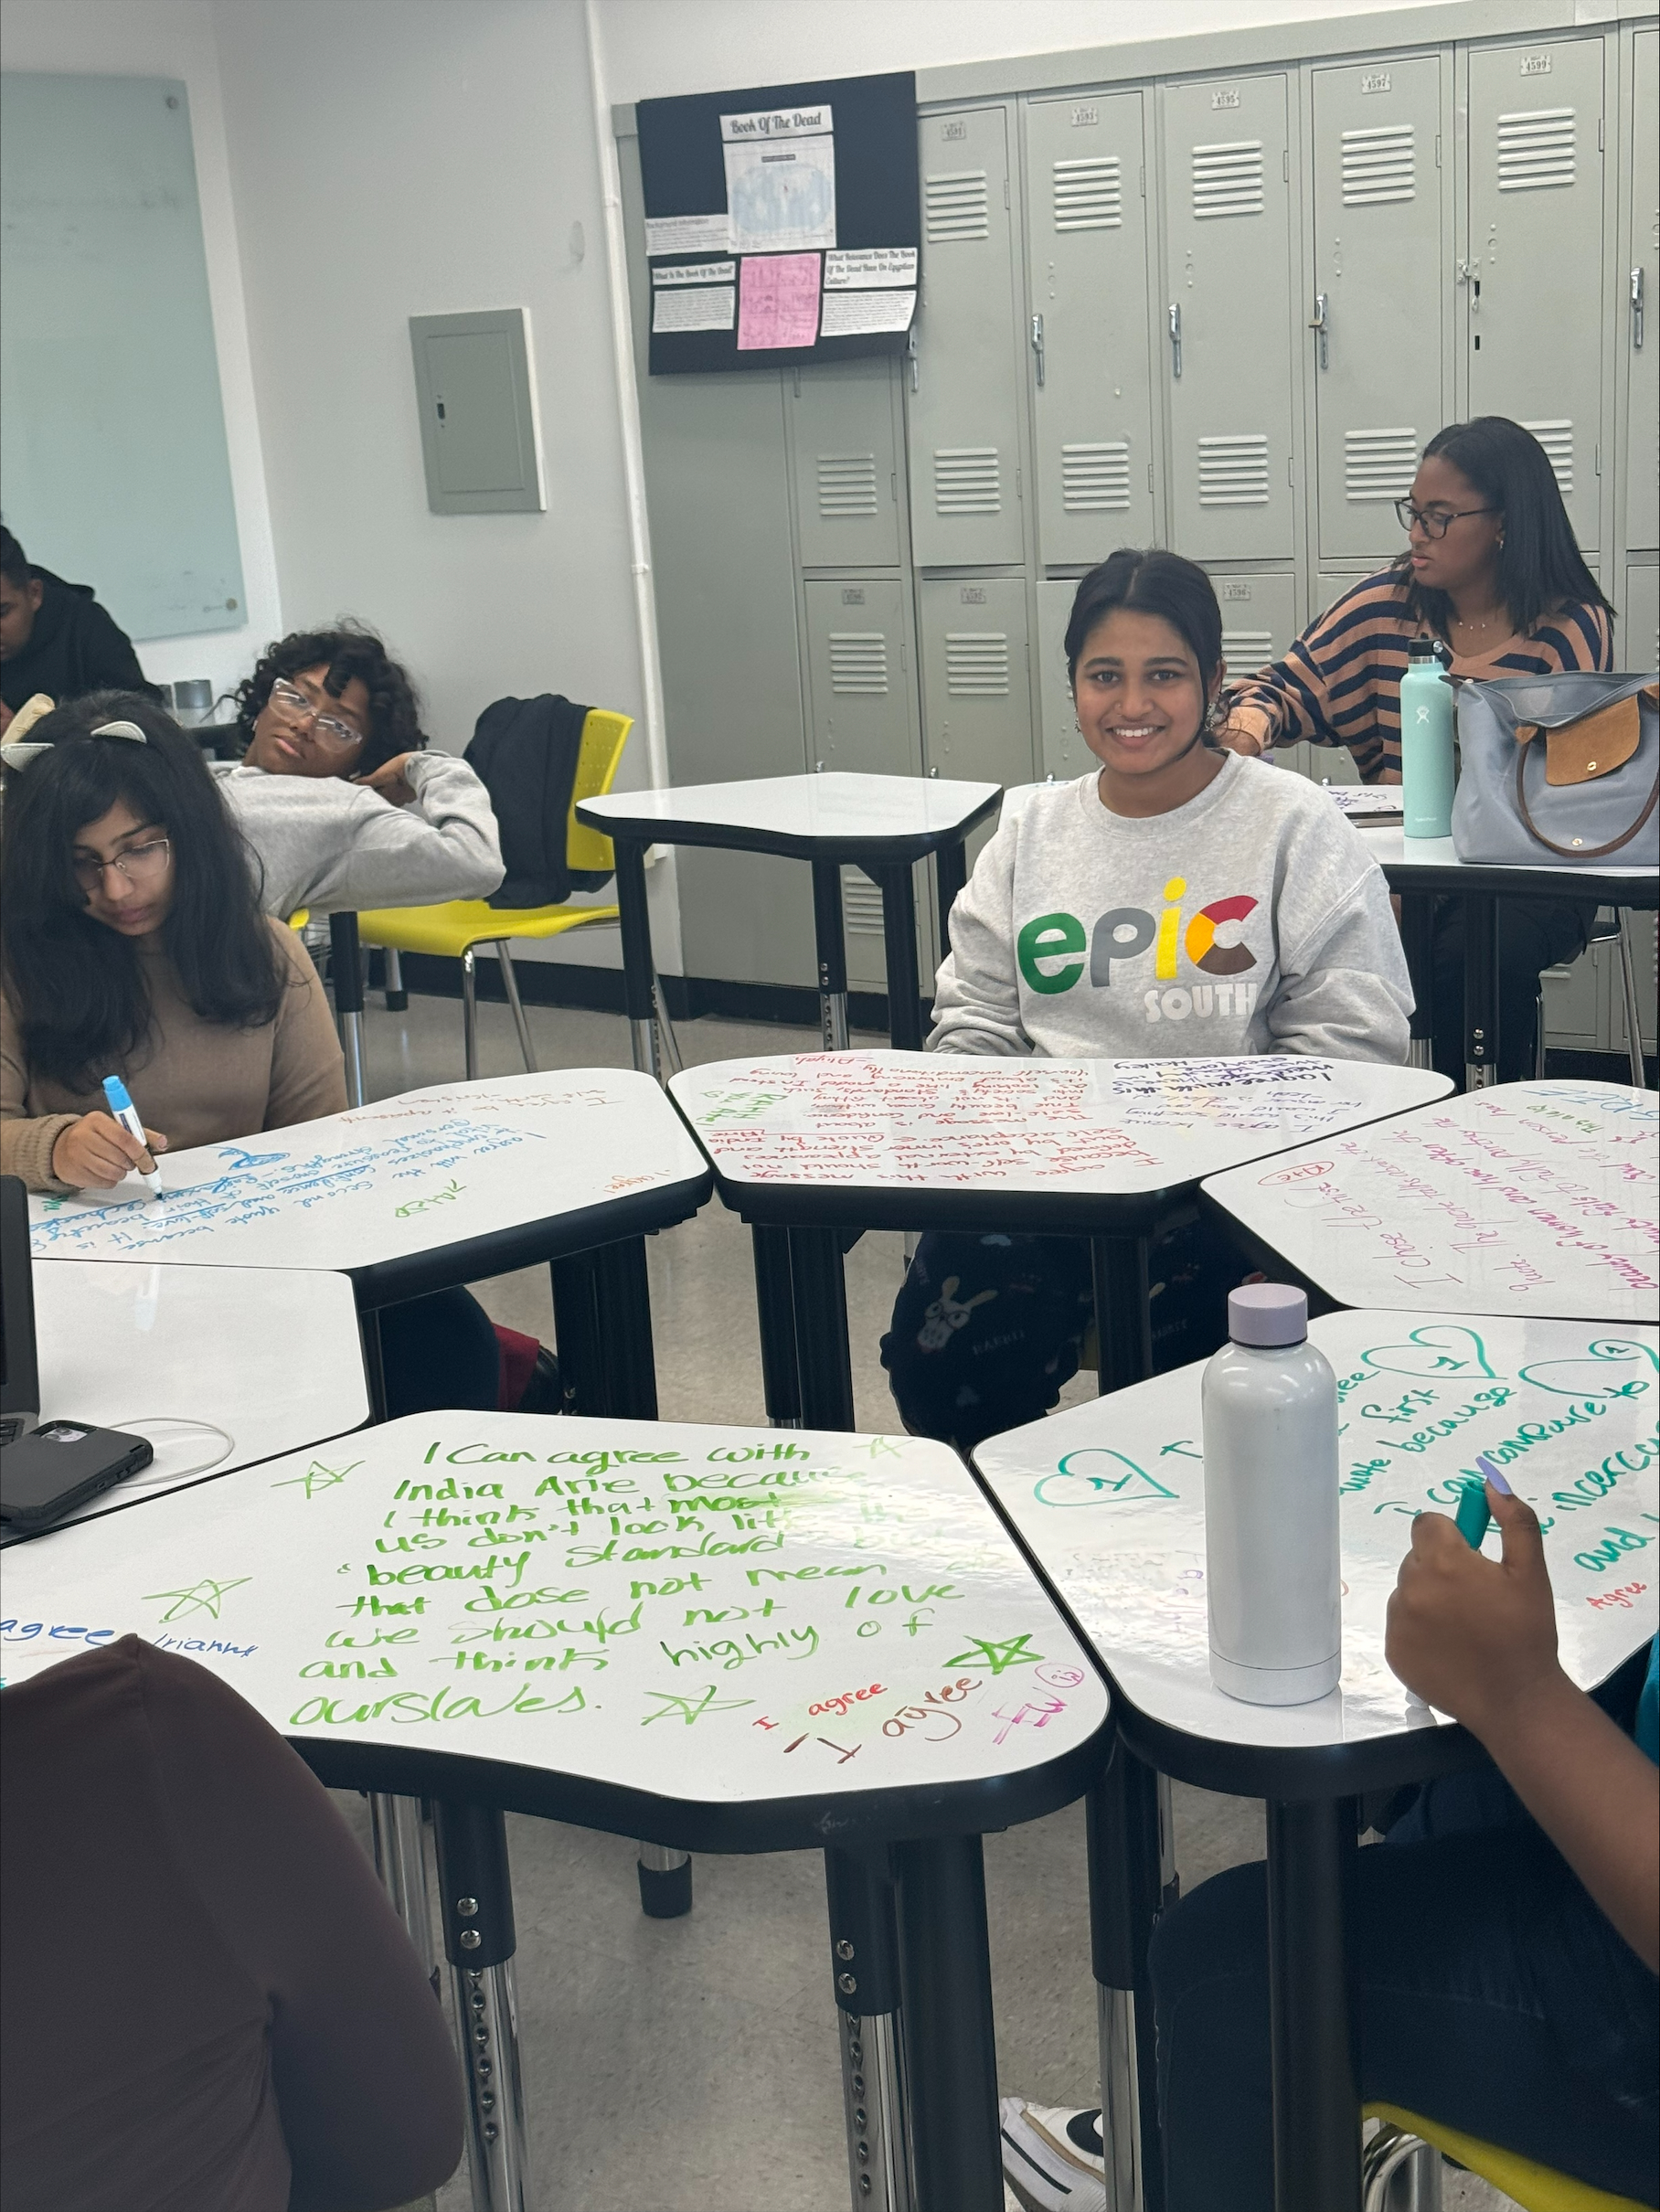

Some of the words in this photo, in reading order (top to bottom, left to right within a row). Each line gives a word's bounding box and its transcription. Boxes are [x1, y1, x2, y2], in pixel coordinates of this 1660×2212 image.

[1524, 59, 1548, 72] 4599
[1366, 77, 1387, 90] 4597
[758, 116, 771, 135] Of
[792, 112, 822, 128] Dead
[1017, 876, 1259, 994] epic
[1144, 984, 1257, 1023] SOUTH
[1165, 1081, 1231, 1093] with
[1235, 1073, 1317, 1086] agree
[781, 1135, 803, 1143] by
[1010, 1148, 1041, 1156] by
[1025, 1138, 1061, 1146] by
[1044, 1150, 1152, 1163] because
[750, 1171, 854, 1180] message
[293, 1180, 374, 1208] second
[117, 1227, 214, 1252] because
[423, 1441, 442, 1464] I
[547, 1448, 689, 1475] agree
[707, 1442, 810, 1463] with
[393, 1477, 505, 1502] India
[534, 1474, 641, 1498] Arie
[420, 1504, 539, 1527] think
[566, 1496, 656, 1515] that
[375, 1532, 448, 1555] us
[467, 1519, 580, 1548] don't
[610, 1515, 705, 1536] look
[367, 1550, 530, 1589] beauty
[335, 1593, 432, 1618] that
[463, 1585, 590, 1612] dose
[629, 1572, 712, 1601] not
[745, 1562, 887, 1588] mean
[325, 1628, 421, 1648] we
[683, 1598, 786, 1626] not
[845, 1583, 966, 1609] love
[298, 1656, 399, 1679] and
[659, 1624, 820, 1669] highly
[856, 1609, 935, 1638] of
[808, 1683, 889, 1717] agree
[881, 1677, 984, 1743] agree
